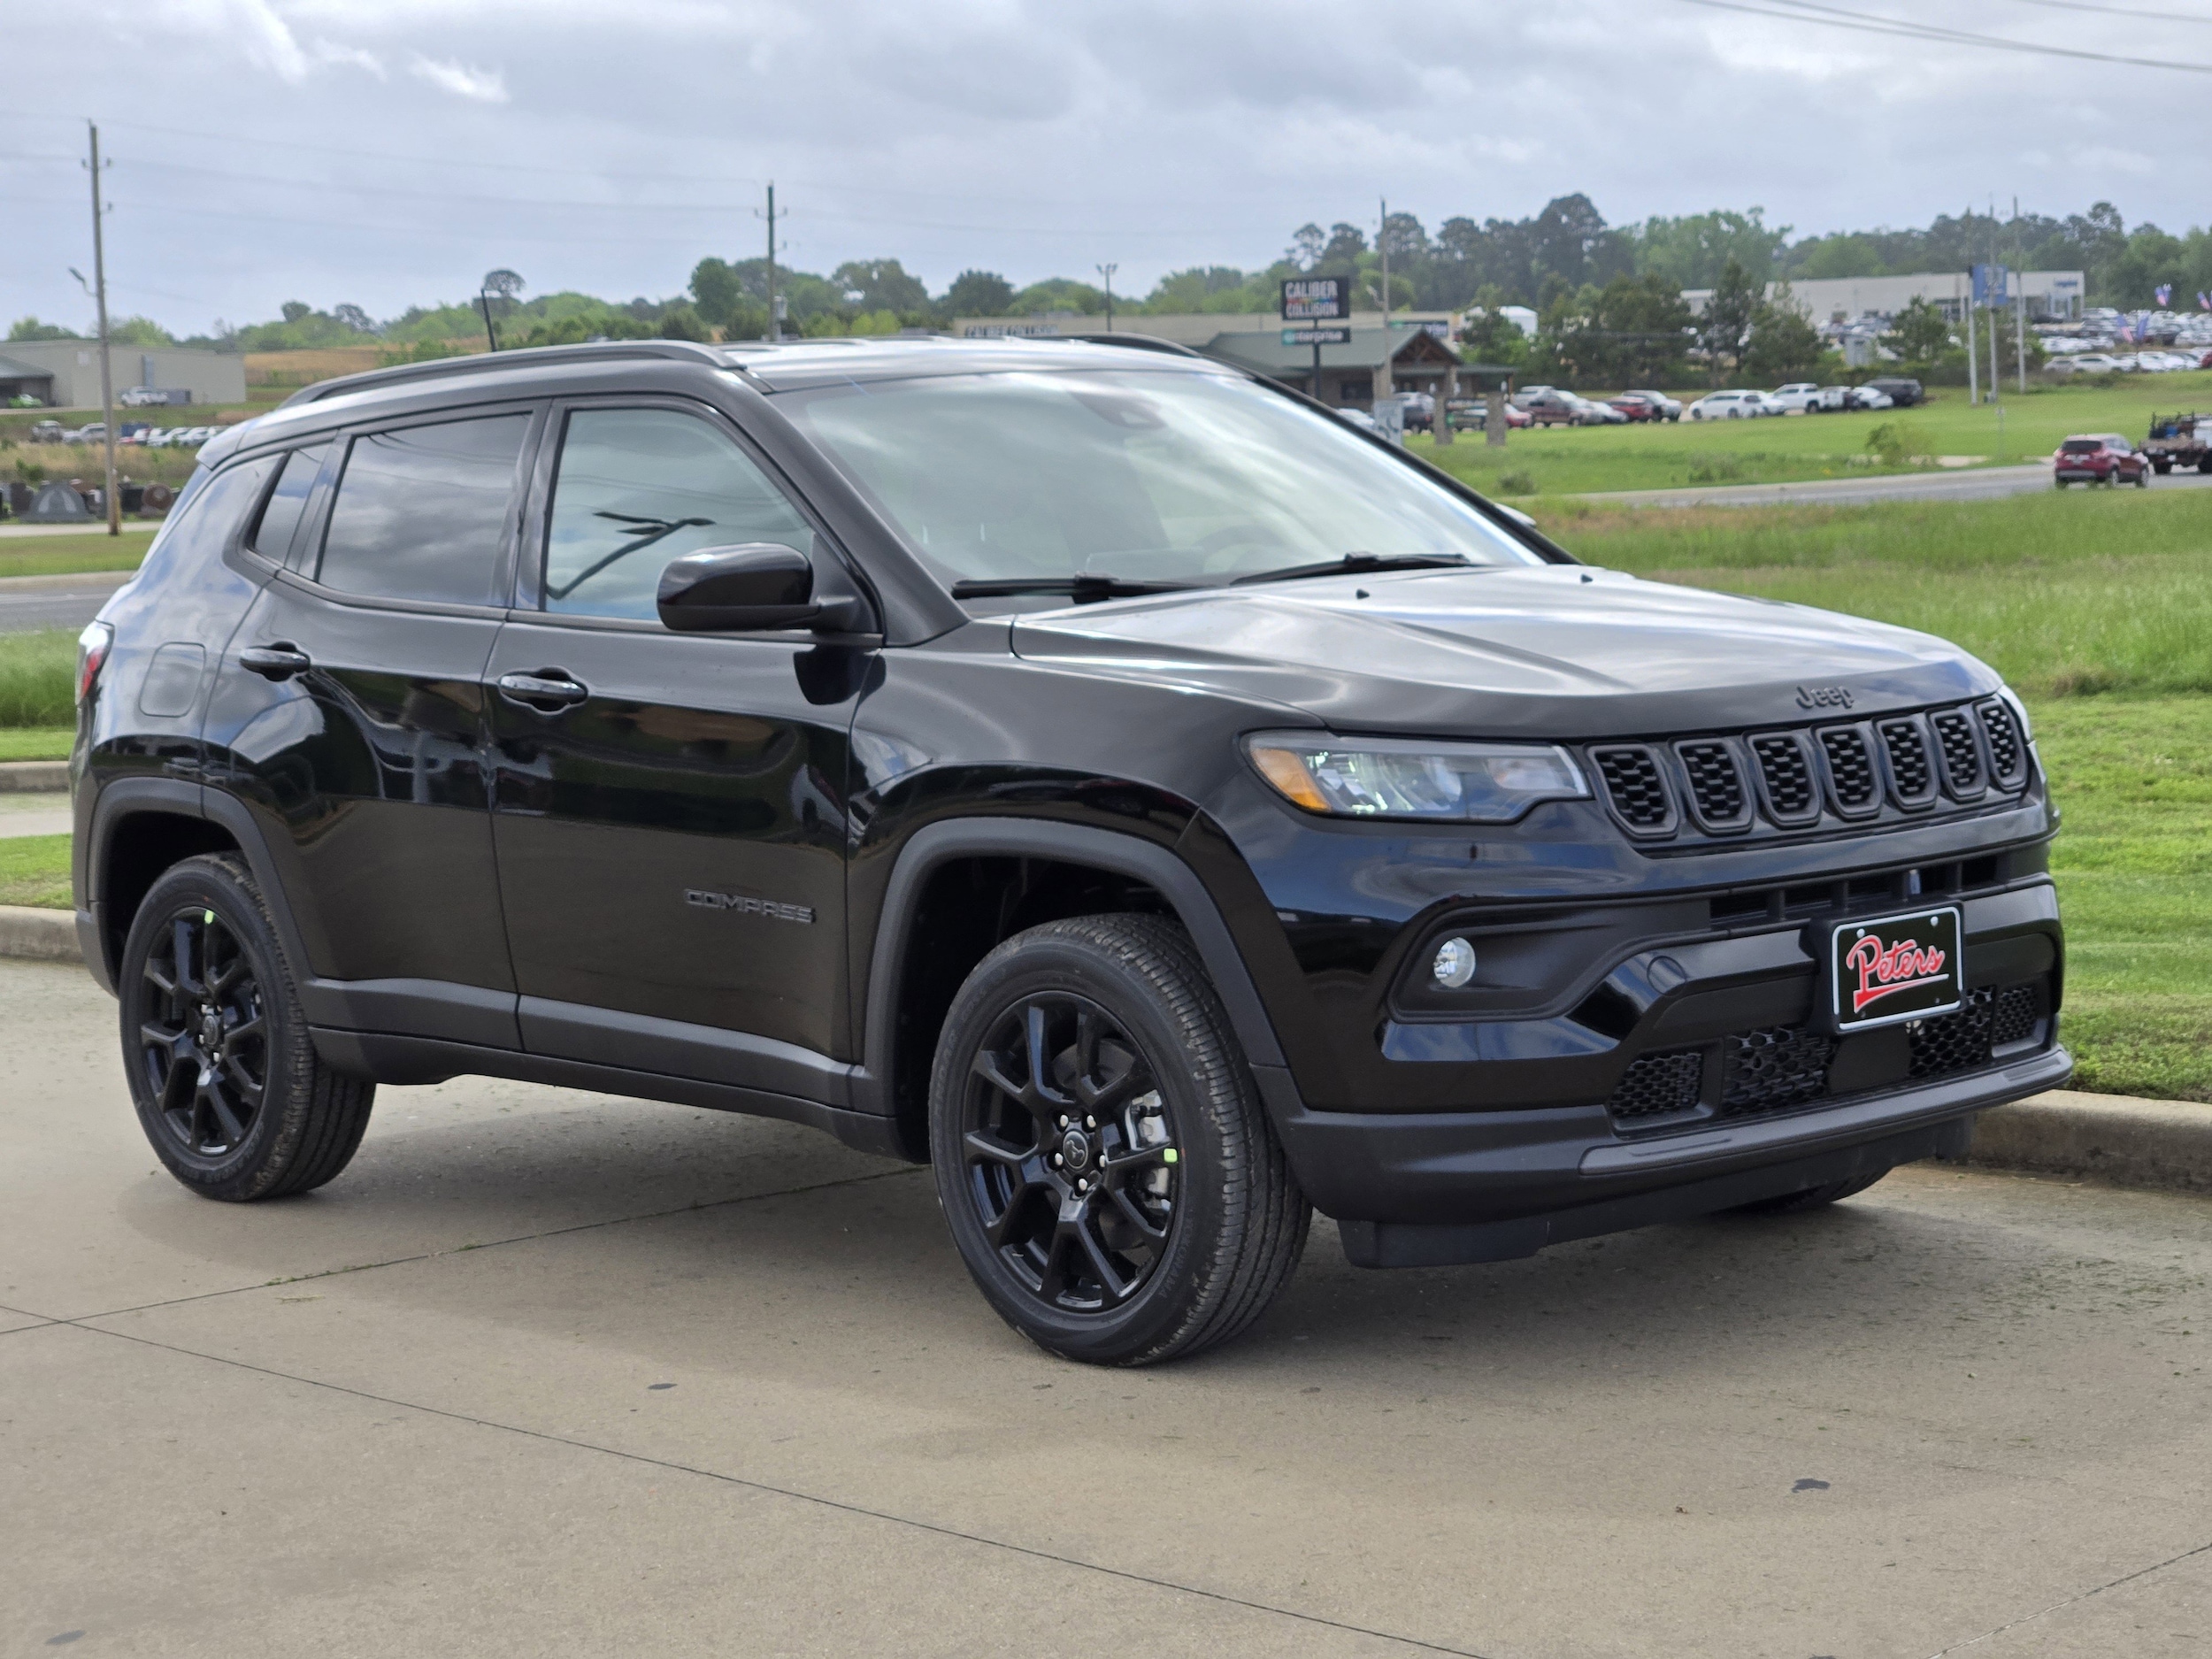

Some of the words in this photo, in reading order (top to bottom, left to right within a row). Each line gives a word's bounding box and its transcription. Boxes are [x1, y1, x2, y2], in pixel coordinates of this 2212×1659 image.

[1286, 280, 1338, 297] CALIBER
[1286, 302, 1339, 319] COLLISION
[1795, 686, 1855, 709] Jeep
[684, 888, 814, 923] COMPASS
[1846, 934, 1946, 995] Peters
